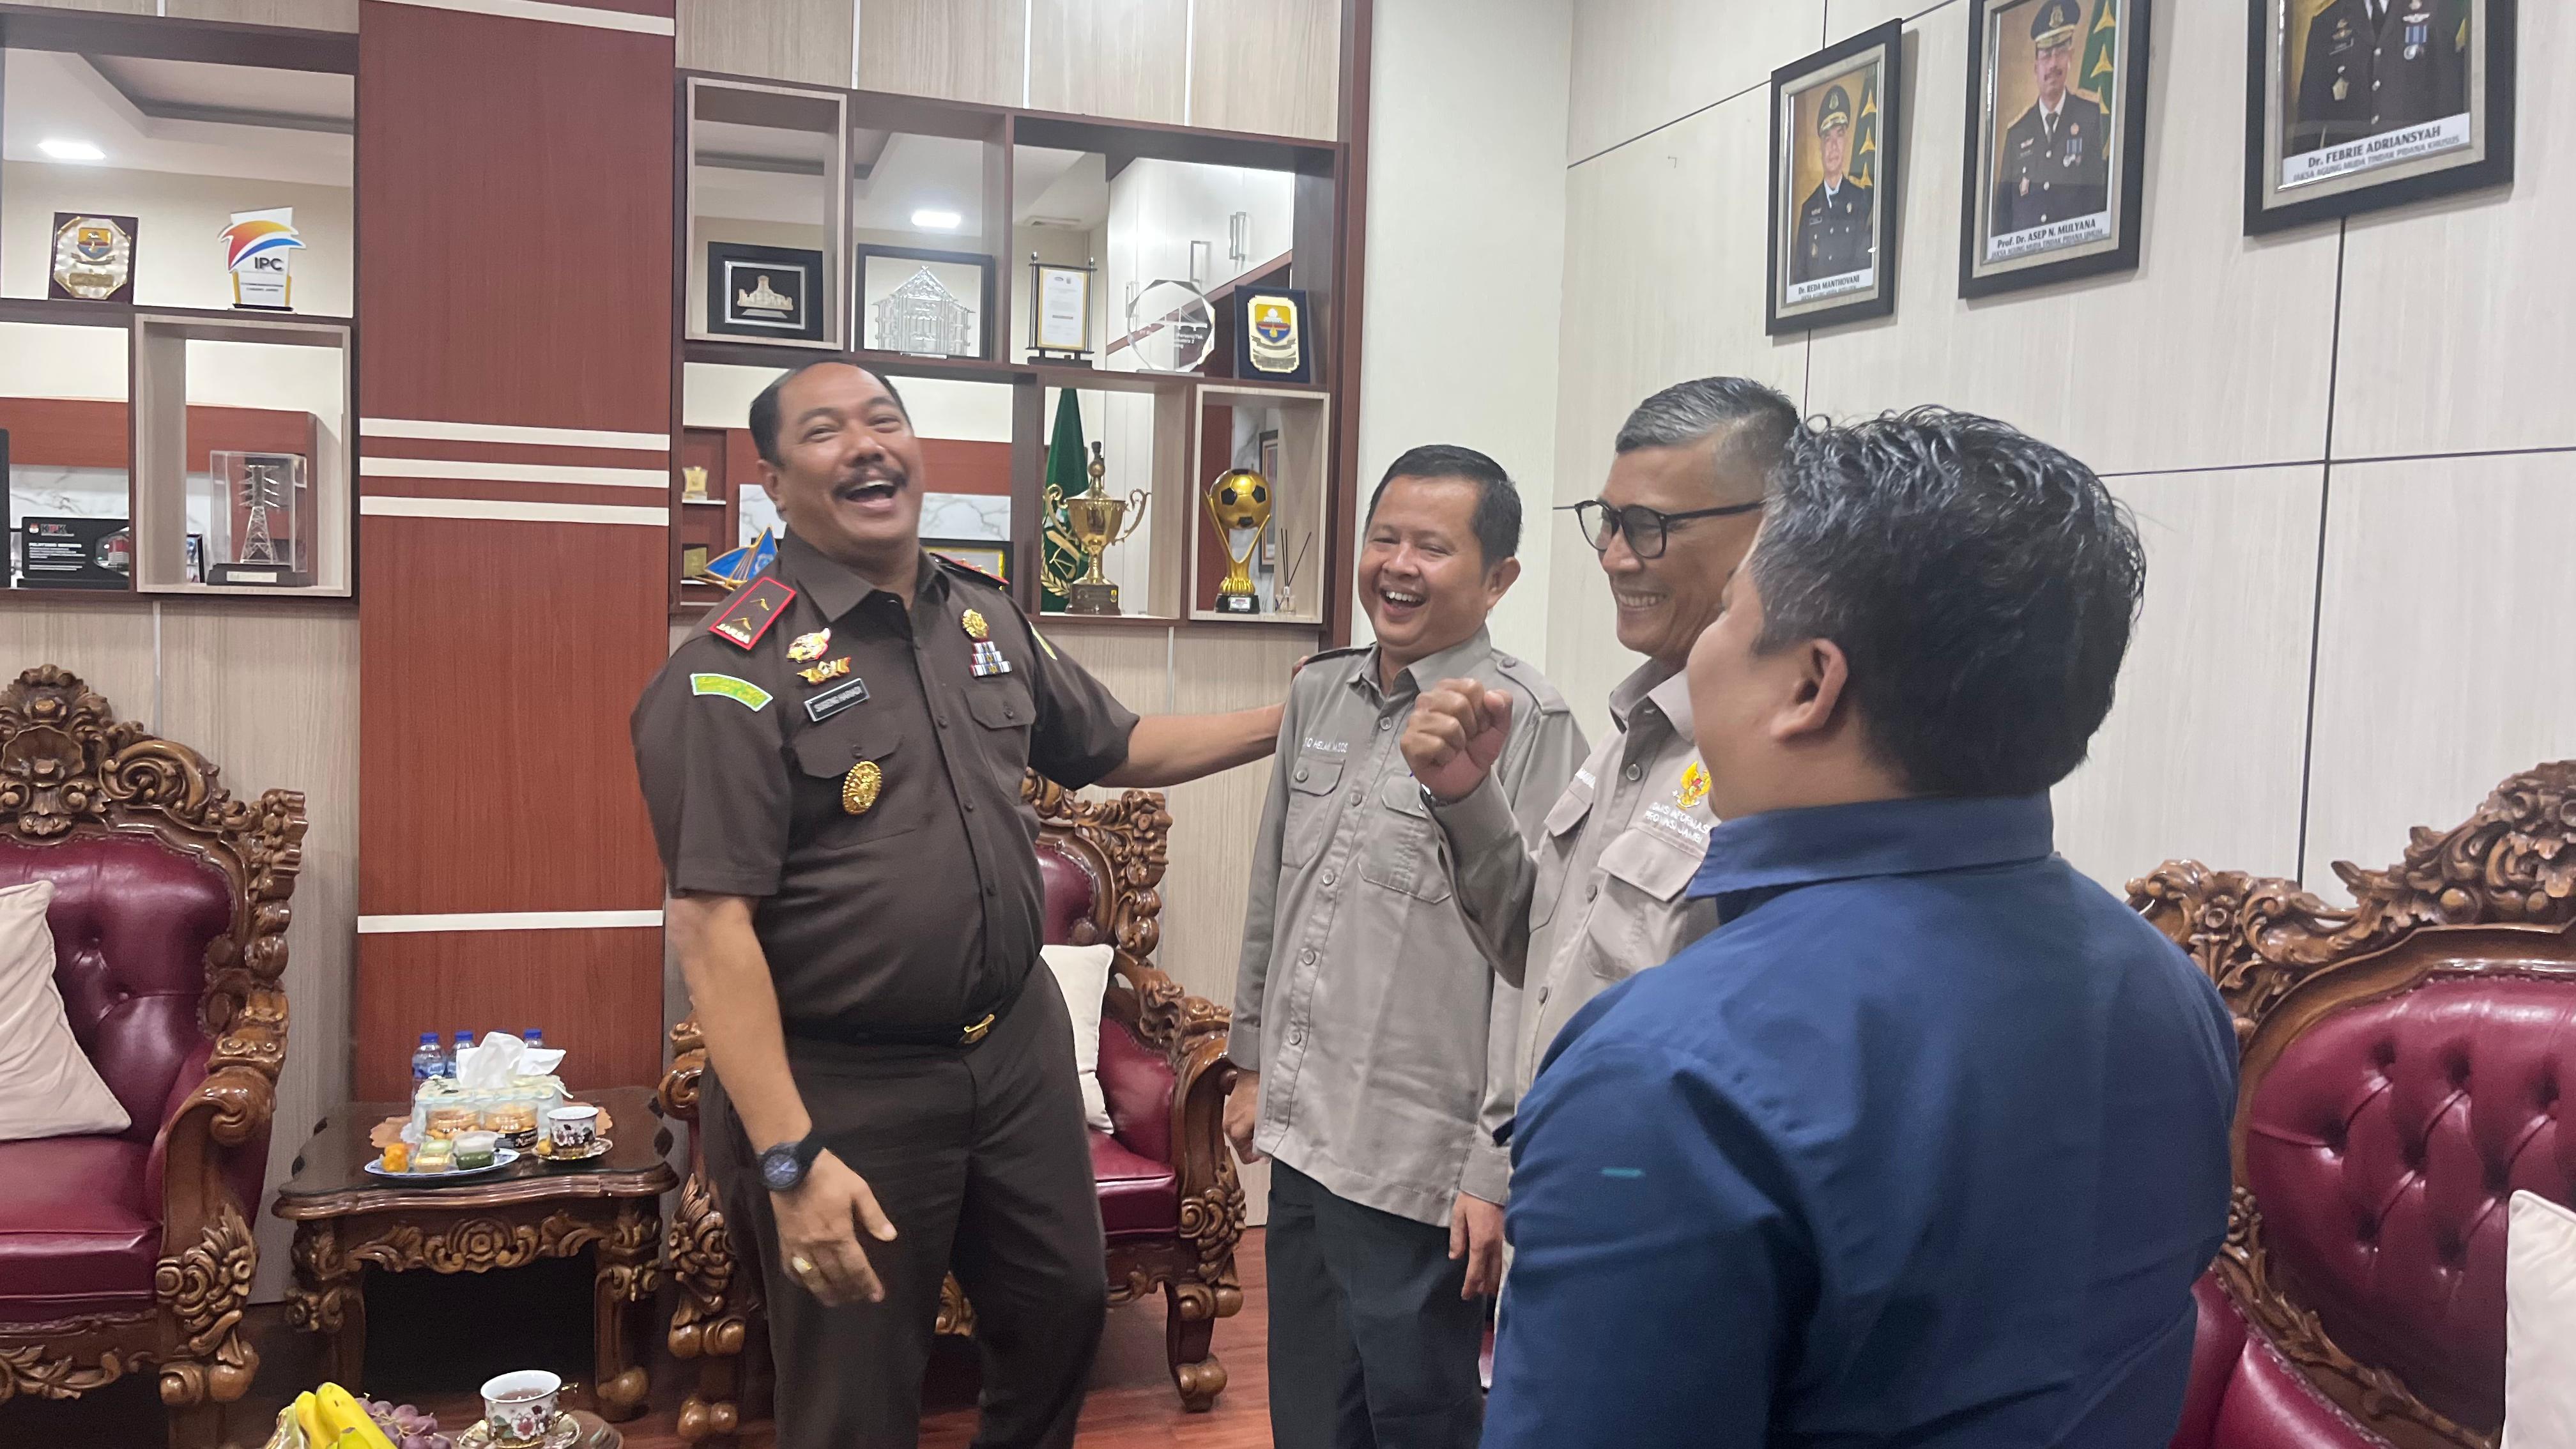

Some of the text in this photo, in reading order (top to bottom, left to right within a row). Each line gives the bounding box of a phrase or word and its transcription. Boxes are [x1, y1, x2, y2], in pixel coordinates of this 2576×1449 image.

[2308, 126, 2441, 167] Dr. FEBRIE ADRIANSYAH
[1997, 218, 2096, 248] Prof. Dr. ASEP N. MULYANA
[254, 257, 284, 272] IPC
[1807, 283, 1821, 293] REDA
[1822, 275, 1860, 289] MANTHOVANI
